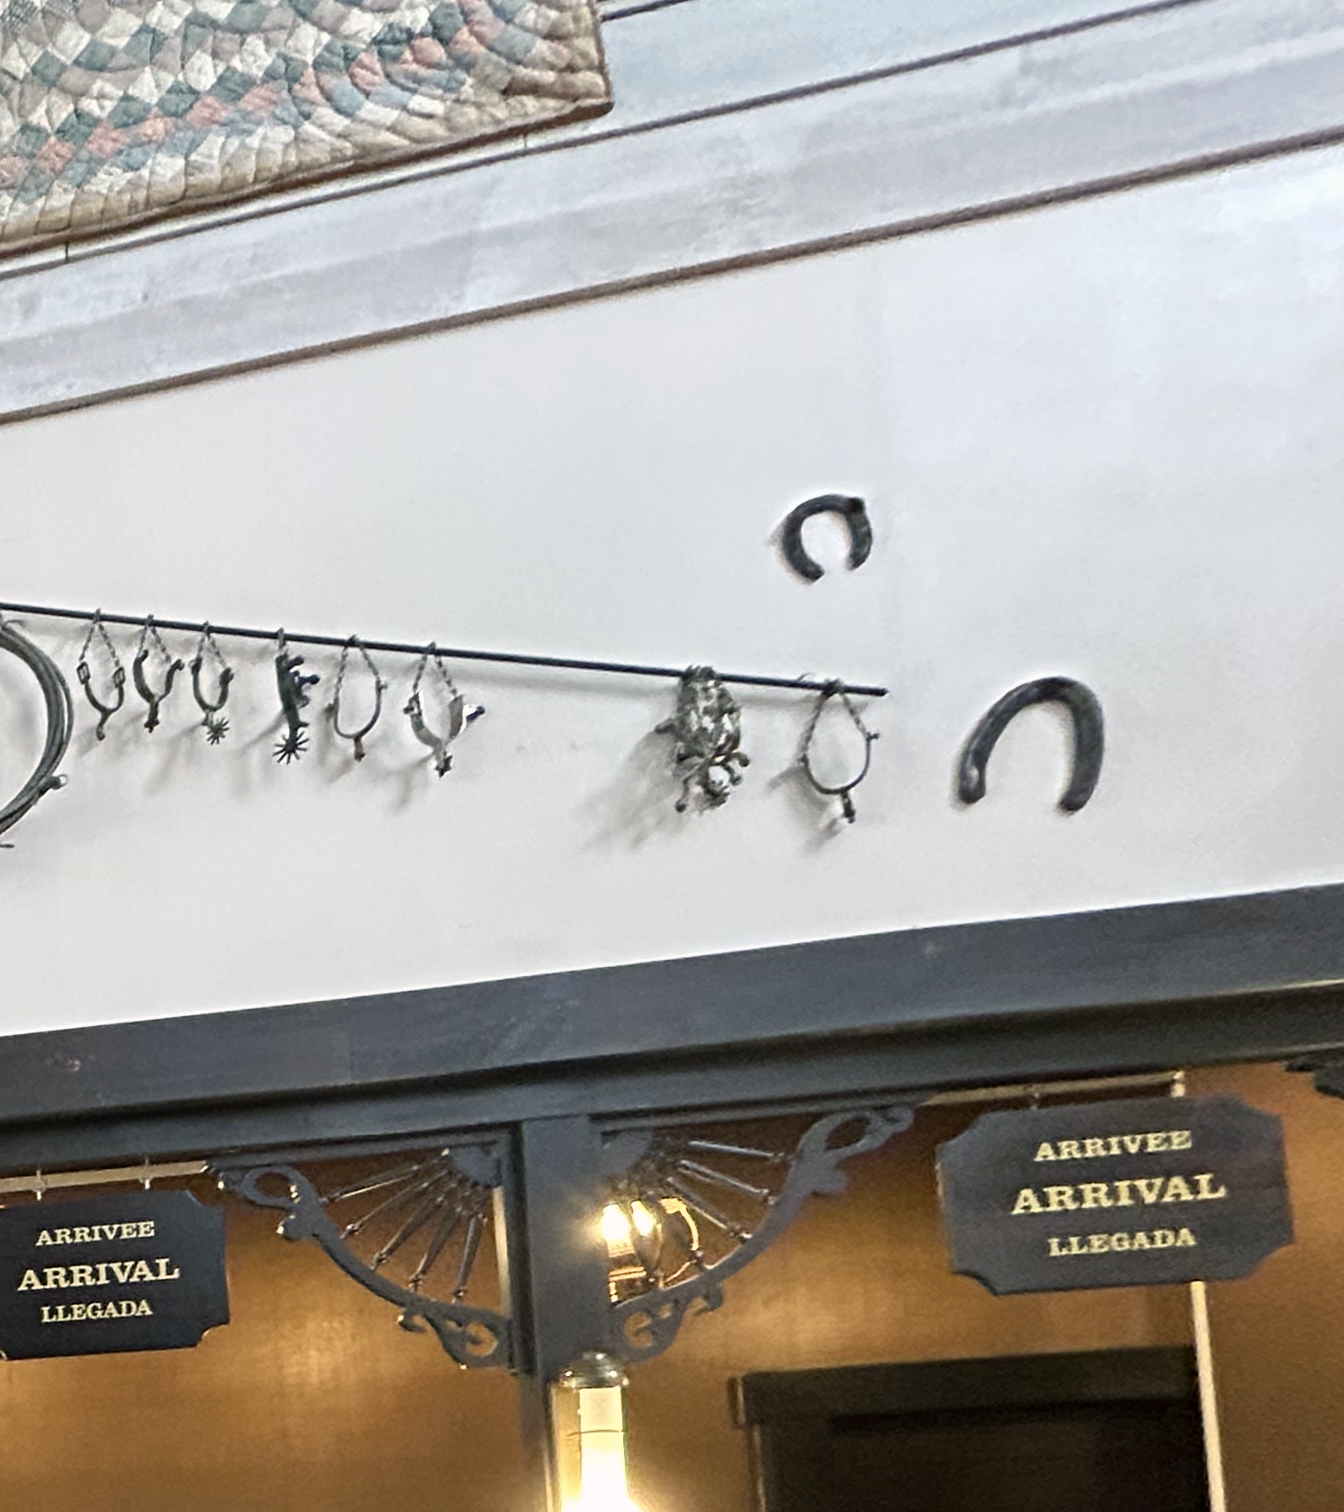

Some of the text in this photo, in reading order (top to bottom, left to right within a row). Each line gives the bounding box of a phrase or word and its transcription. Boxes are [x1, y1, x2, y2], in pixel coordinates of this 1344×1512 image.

[1033, 1130, 1192, 1161] ARRIVEE
[1011, 1173, 1227, 1215] ARRIVAL
[36, 1221, 155, 1246] ARRIVEE
[1048, 1228, 1197, 1257] LLEGADA
[17, 1258, 180, 1291] ARRIVAL
[41, 1300, 153, 1323] LLEGADA
